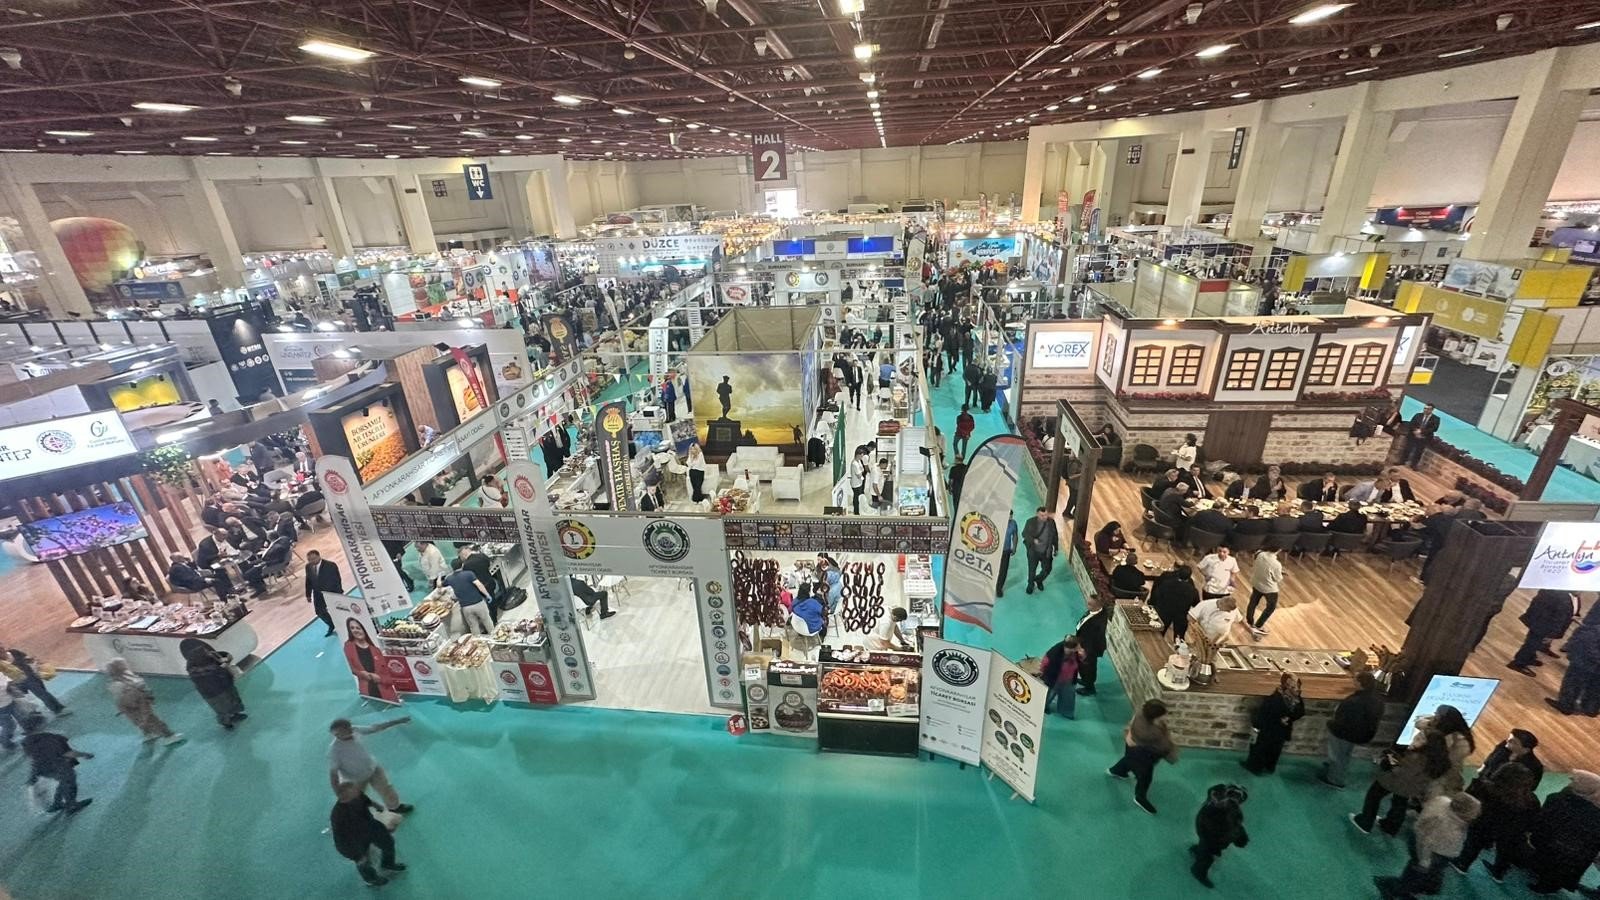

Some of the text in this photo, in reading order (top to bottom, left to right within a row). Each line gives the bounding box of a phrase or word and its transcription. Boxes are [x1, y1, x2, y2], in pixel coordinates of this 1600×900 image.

[754, 134, 783, 145] HALL
[760, 150, 781, 179] 2
[471, 179, 485, 187] WC
[642, 239, 680, 249] DÜZCE
[1248, 320, 1309, 337] Antalya
[1534, 540, 1594, 563] Antalya
